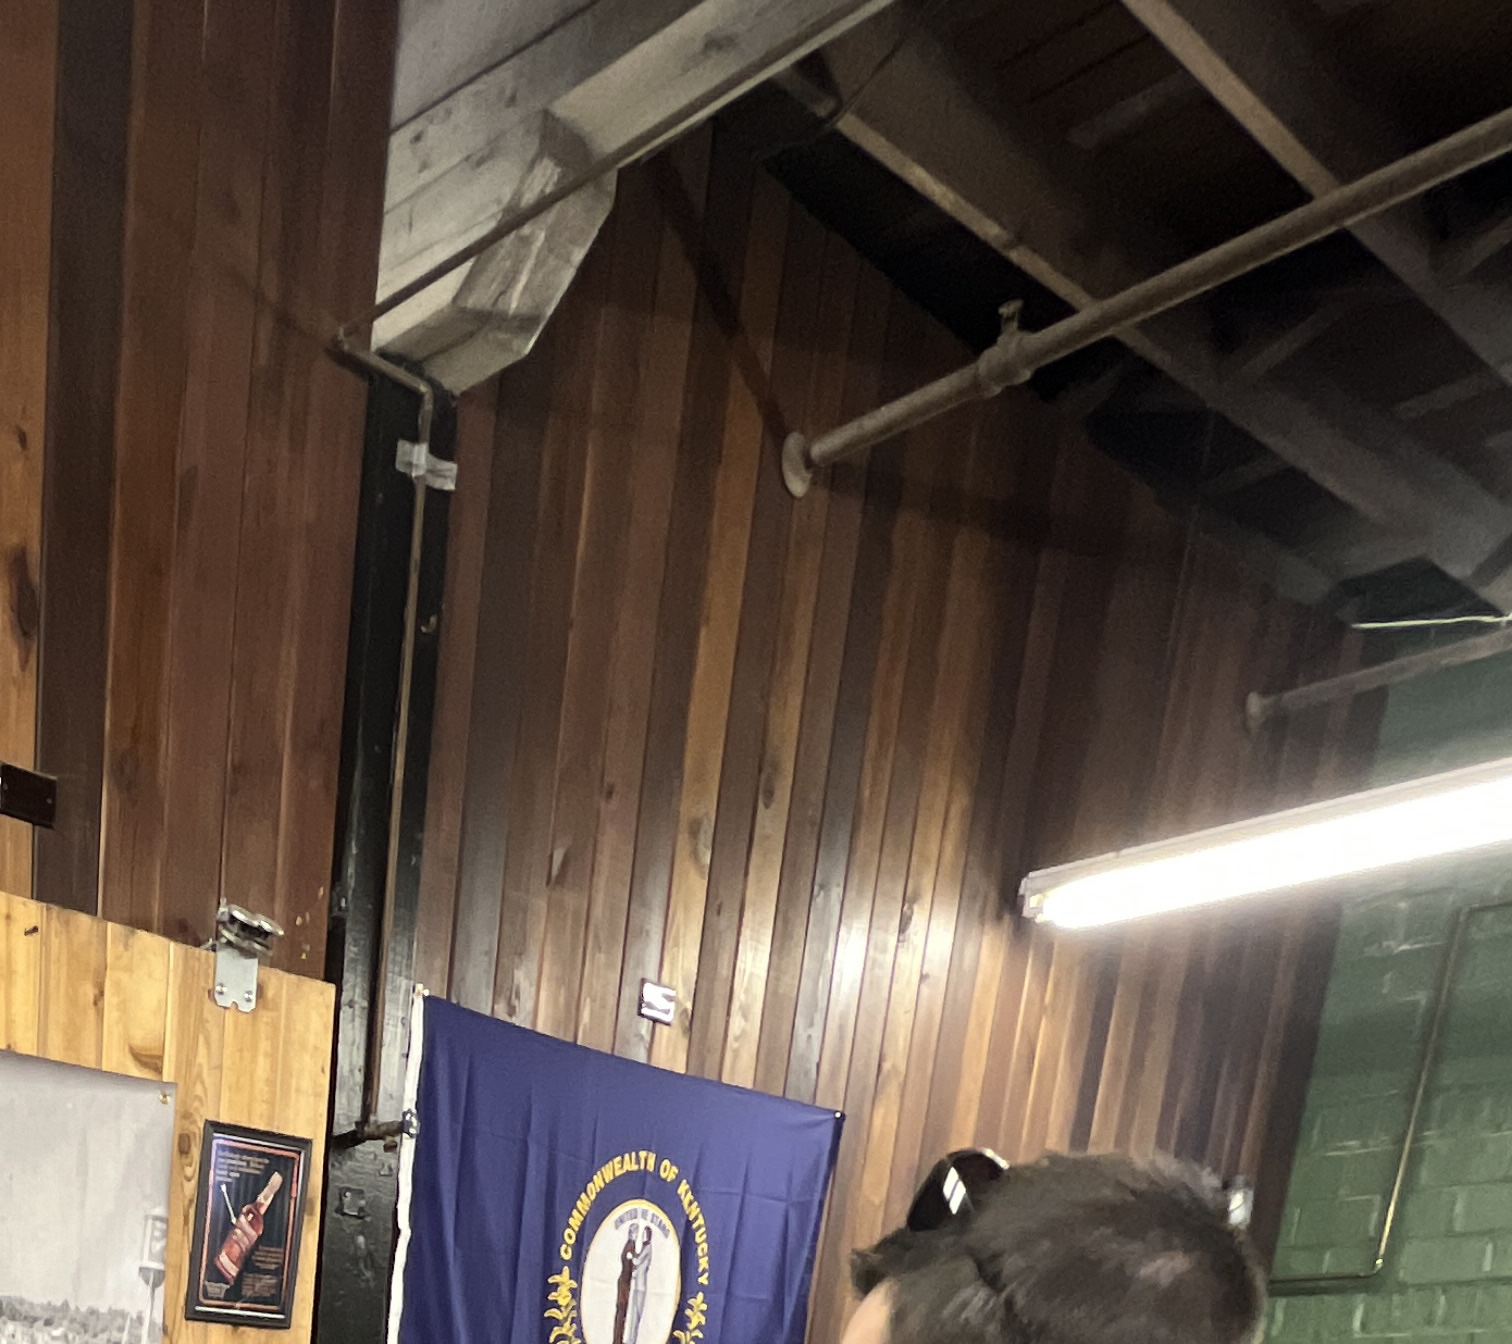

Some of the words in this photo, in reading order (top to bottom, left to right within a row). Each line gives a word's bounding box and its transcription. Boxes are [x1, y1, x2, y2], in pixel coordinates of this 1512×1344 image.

[560, 1150, 657, 1260] COMMONWEALTH
[659, 1159, 679, 1182] OF
[677, 1179, 709, 1285] KENTUCKY
